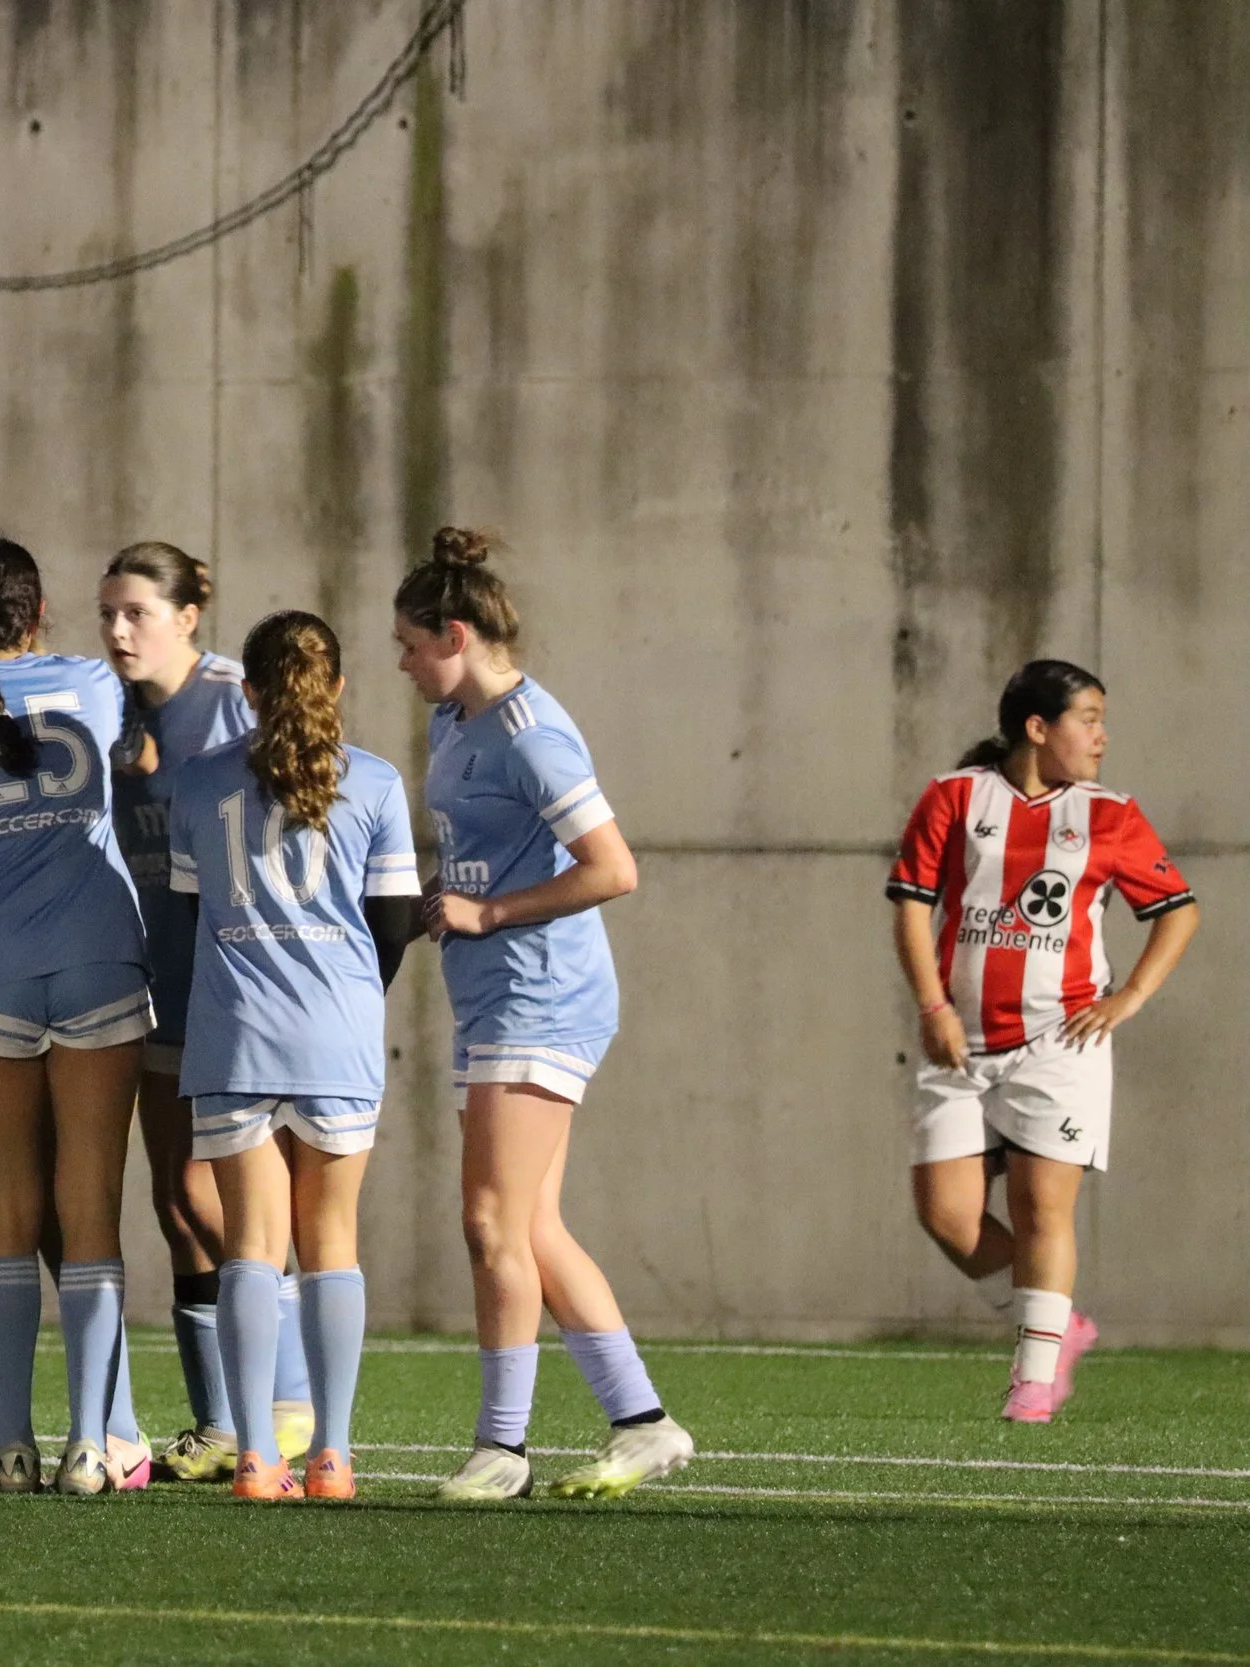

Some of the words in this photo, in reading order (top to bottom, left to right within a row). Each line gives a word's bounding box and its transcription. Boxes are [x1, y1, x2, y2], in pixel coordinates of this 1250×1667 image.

[218, 788, 329, 906] 10
[965, 904, 1014, 925] rede
[958, 921, 1064, 953] ambiente
